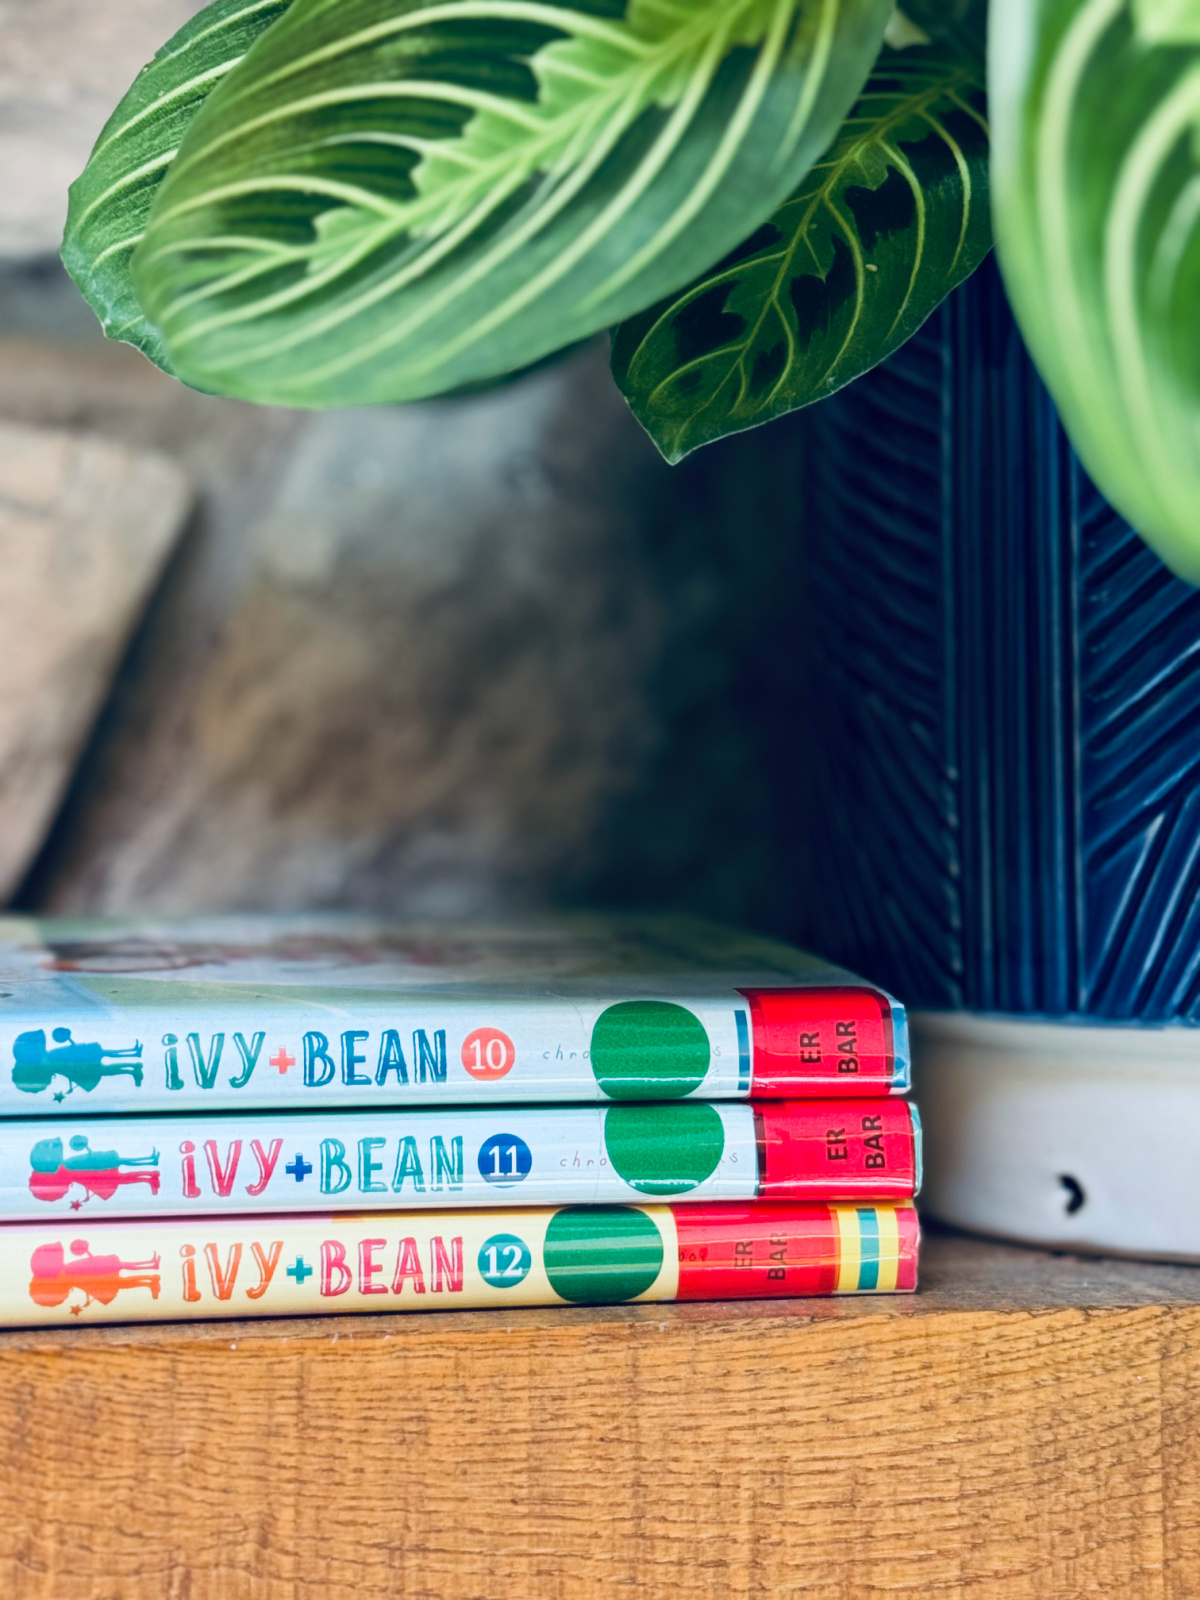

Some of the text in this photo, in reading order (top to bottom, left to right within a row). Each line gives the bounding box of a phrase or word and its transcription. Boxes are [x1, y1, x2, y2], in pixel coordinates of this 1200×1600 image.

[302, 1029, 448, 1087] BEAN
[468, 1038, 507, 1070] 10
[800, 1031, 822, 1063] ER
[836, 1020, 859, 1074] BAR
[319, 1136, 464, 1194] BEAN
[488, 1145, 522, 1177] 11
[826, 1127, 848, 1160] ER
[862, 1115, 886, 1169] BAR
[320, 1236, 464, 1296] BEAN
[484, 1245, 523, 1278] 12
[734, 1241, 753, 1271] ER
[767, 1232, 787, 1280] BAR
